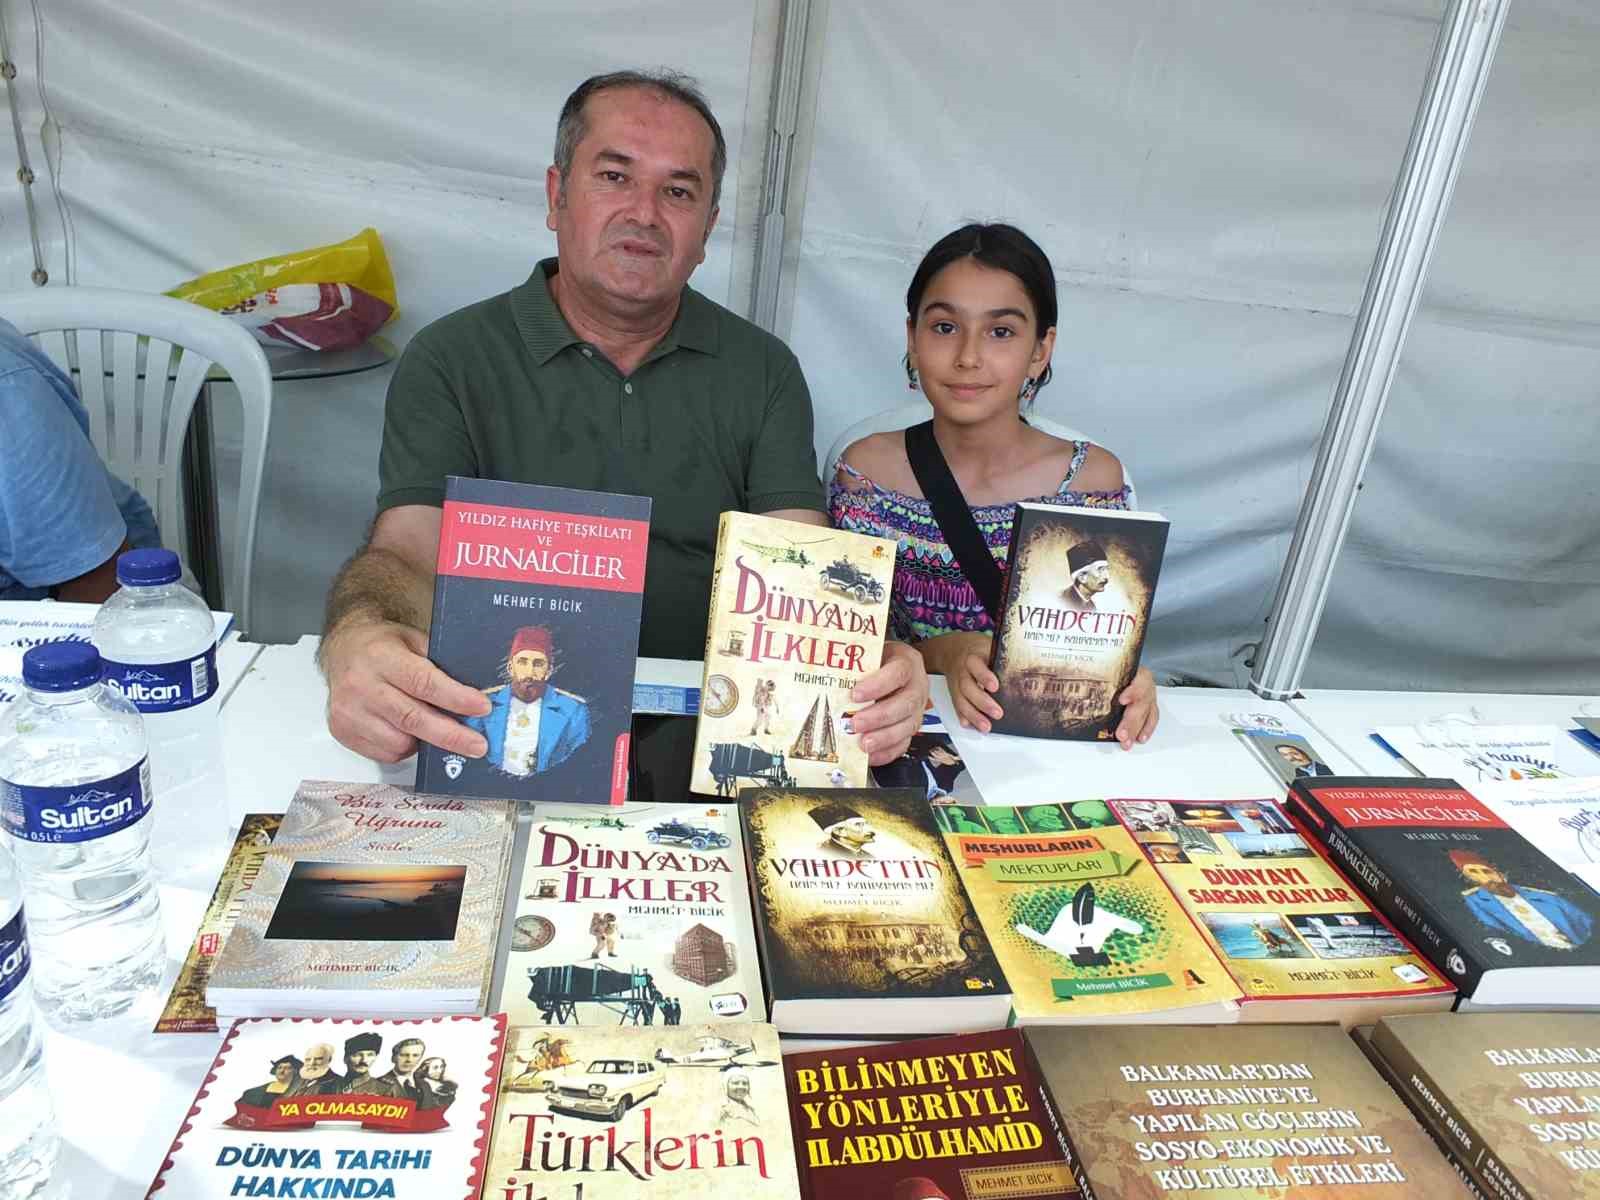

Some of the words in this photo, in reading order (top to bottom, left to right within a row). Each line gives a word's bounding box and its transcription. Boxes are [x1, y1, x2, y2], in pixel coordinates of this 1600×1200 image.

[458, 510, 507, 528] YILDIZ
[511, 516, 560, 533] HAFİYE
[537, 535, 552, 546] VE
[455, 542, 625, 580] JURNALCİLER
[493, 593, 544, 609] MEHMET
[729, 555, 878, 636] DÜNYA'DA
[1018, 604, 1137, 635] VAHDETTİN
[746, 615, 865, 673] İLKLER
[108, 679, 181, 700] Sultan
[794, 671, 835, 687] MEHMET
[839, 677, 857, 690] BİCİ
[334, 794, 384, 808] Bir
[40, 797, 133, 829] Sultan
[1344, 805, 1491, 823] JURNALCİLER
[1402, 832, 1449, 840] MEHMET
[534, 825, 733, 872] DÜNYA'DA
[964, 839, 1094, 856] MEŞHURLARIN
[770, 855, 942, 879] VAHDETTİN
[1000, 859, 1102, 876] MEKTUPLARI
[1201, 863, 1310, 886] DÜNYAYI
[559, 865, 725, 903] İLKLER
[1188, 888, 1266, 905] SARSAN
[1267, 887, 1353, 903] OLAYLAR
[628, 904, 683, 915] MEHMET
[306, 963, 362, 973] MEHMET
[1288, 967, 1337, 981] MEHMET
[1484, 1048, 1600, 1066] BALKANLA
[796, 1047, 1017, 1095] BİLİNMEYEN
[1120, 1063, 1313, 1082] BALKANLAR'DAN
[1518, 1070, 1600, 1089] BURHA
[279, 1103, 299, 1117] YA
[305, 1102, 409, 1119] OLMASAYDI!
[801, 1083, 1030, 1130] YÖNLERİYLE
[1513, 1095, 1600, 1115] YAPILA
[1130, 1113, 1240, 1134] YAPILAN
[1242, 1107, 1363, 1134] GÖÇLERİN
[509, 1107, 775, 1181] Türklerin
[806, 1115, 1043, 1168] II.ABDÜLHAMİD
[1135, 1133, 1354, 1161] SOSYO-EKONOMİK
[1353, 1135, 1391, 1155] VE
[215, 1143, 321, 1170] DÜNYA
[976, 1175, 1024, 1190] MEHMET
[1026, 1171, 1055, 1185] BİCİK
[1156, 1164, 1289, 1191] KÜLTÜREL
[1288, 1160, 1407, 1185] ETKİLERİ
[230, 1176, 397, 1199] HAKKINDA
